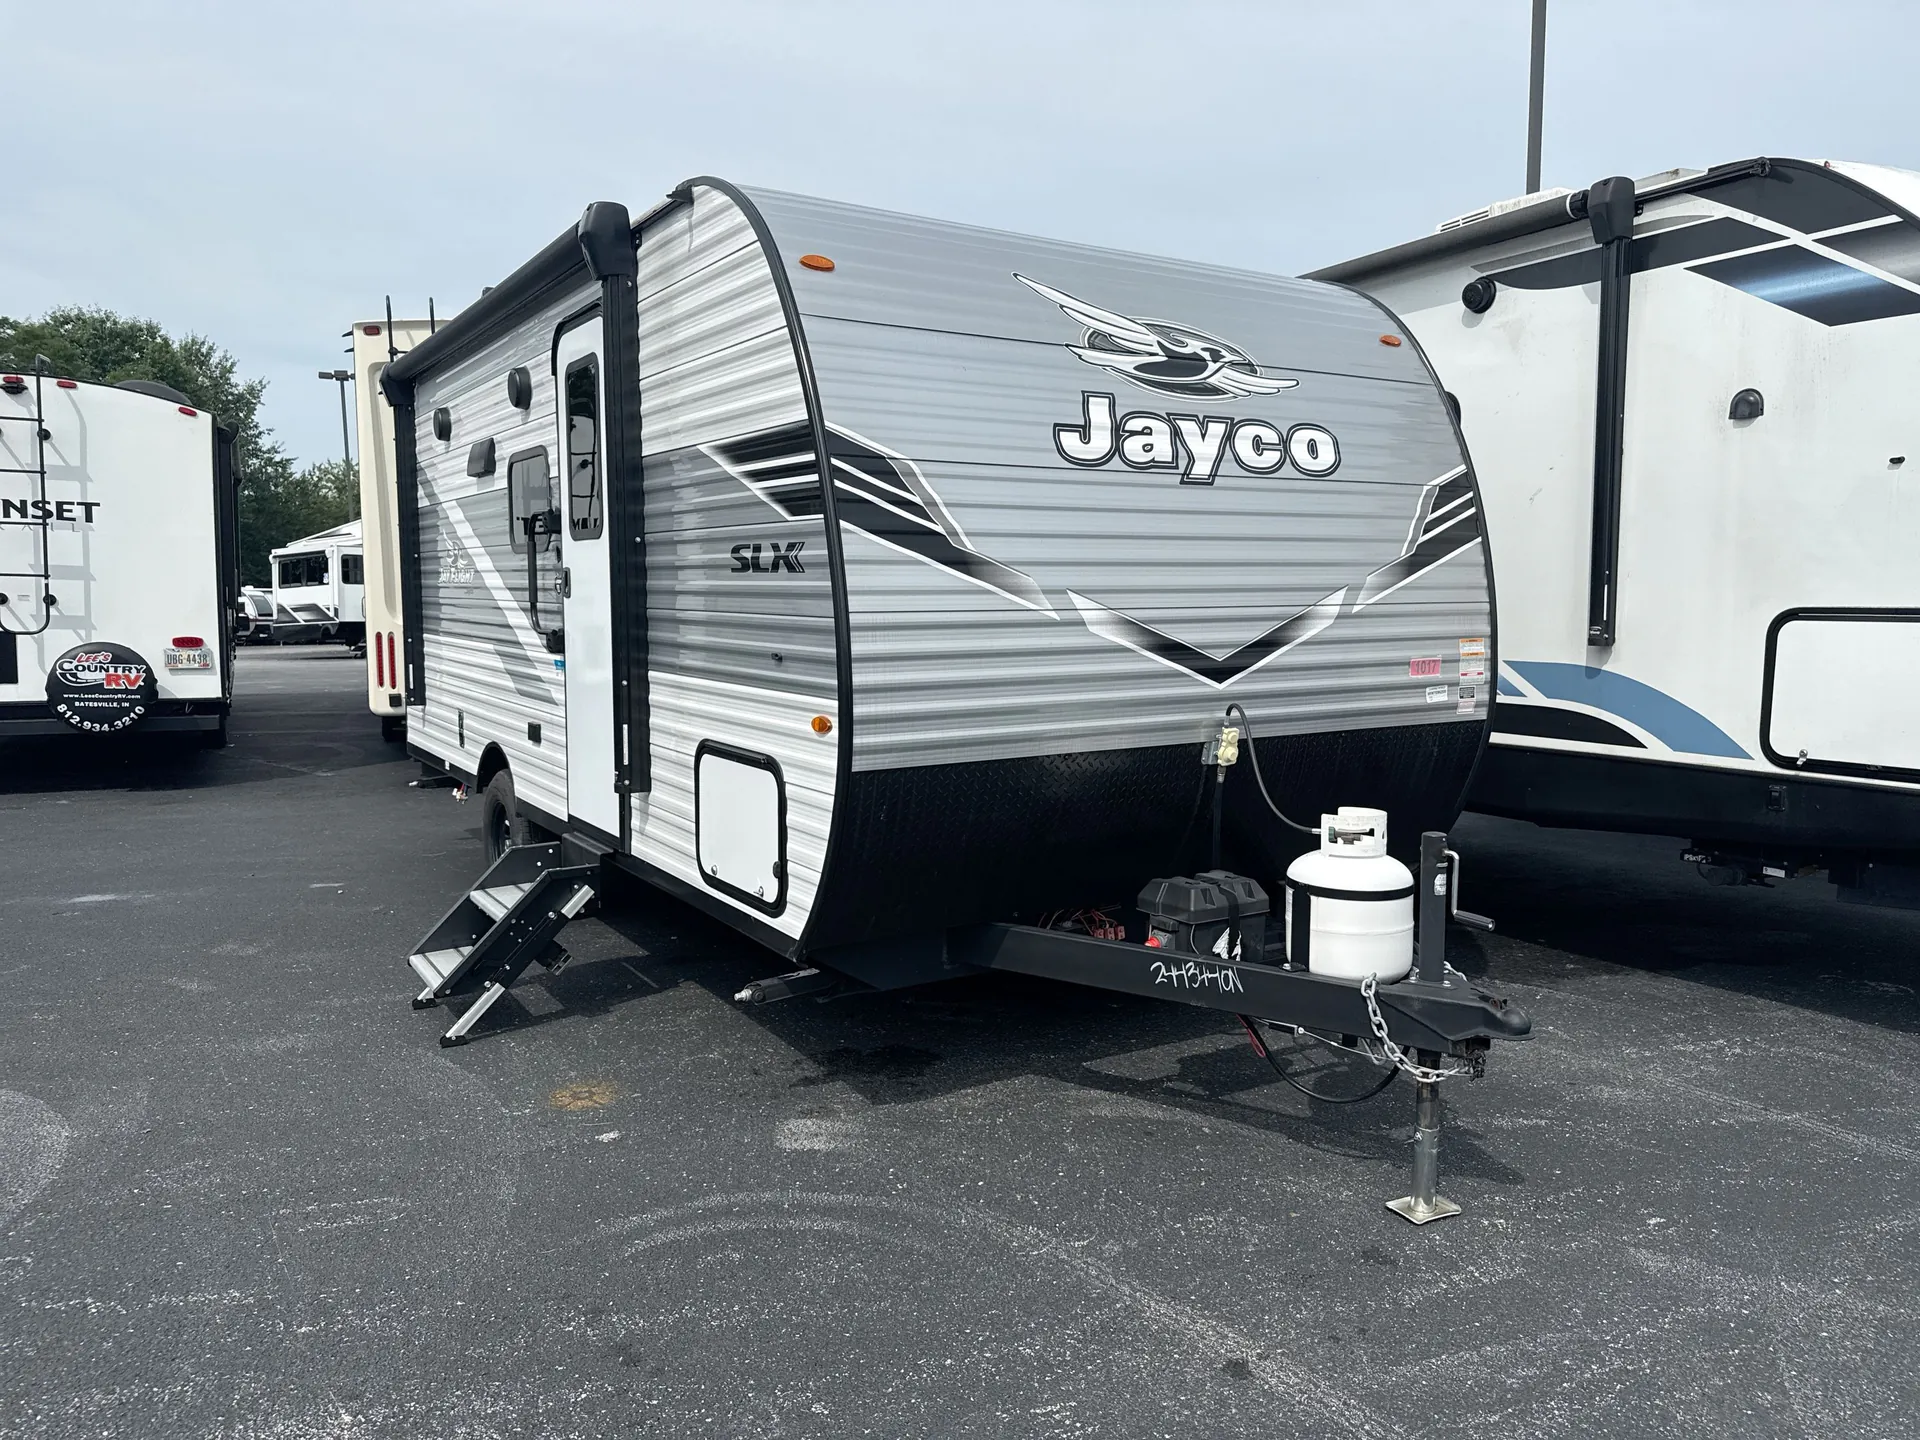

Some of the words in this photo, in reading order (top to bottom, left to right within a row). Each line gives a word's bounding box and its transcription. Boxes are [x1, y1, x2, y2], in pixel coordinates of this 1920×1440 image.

[1053, 390, 1341, 485] Jayco
[730, 541, 805, 574] SLX
[56, 659, 146, 674] COUNTRY
[76, 652, 112, 664] LEE'S
[1415, 660, 1437, 674] 1017
[104, 673, 146, 690] RV
[57, 703, 145, 732] 812.934.3210
